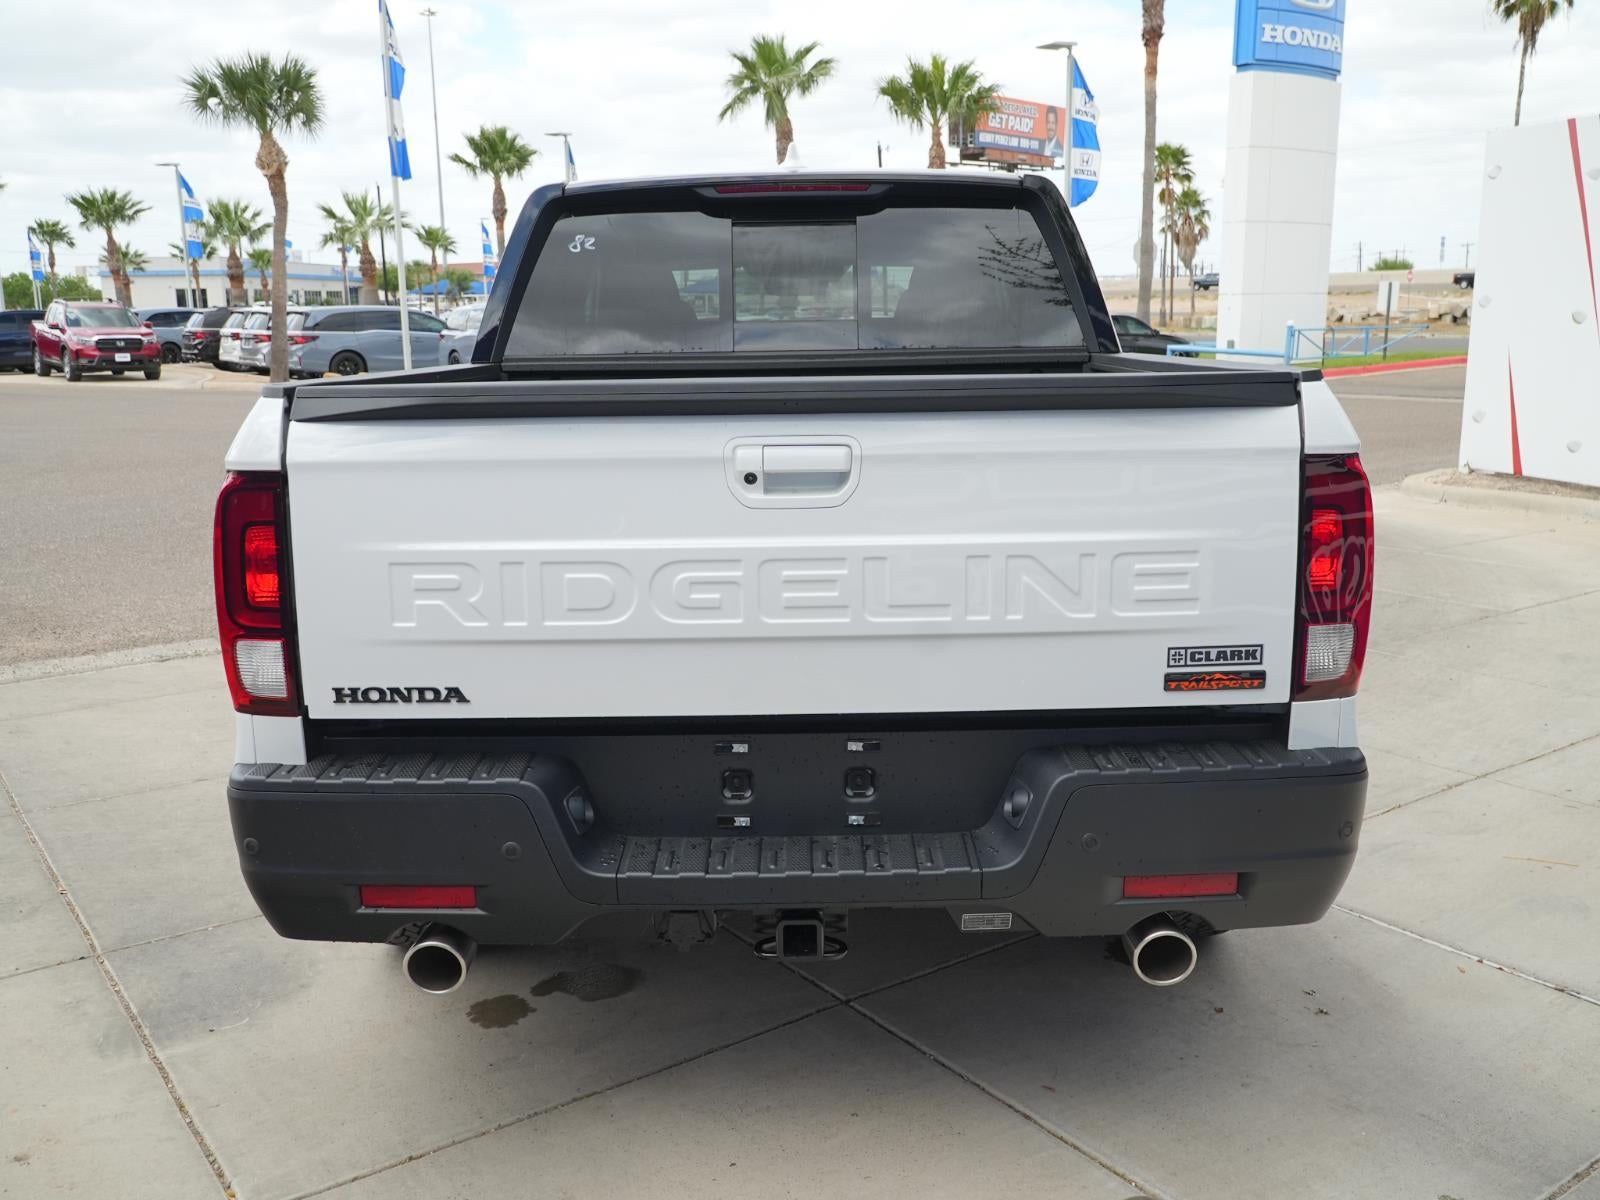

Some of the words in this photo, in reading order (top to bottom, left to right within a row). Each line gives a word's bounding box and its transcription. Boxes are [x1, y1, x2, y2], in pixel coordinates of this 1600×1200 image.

[1261, 23, 1342, 52] HONDA
[988, 112, 1008, 129] GET
[1008, 115, 1034, 133] PAID!
[1073, 167, 1097, 177] HONDA
[568, 234, 596, 252] 82
[388, 550, 1201, 627] RIDGELINE
[1189, 649, 1258, 662] CLARK
[1167, 680, 1263, 690] TRAILSPORT
[332, 687, 471, 704] HONDA
